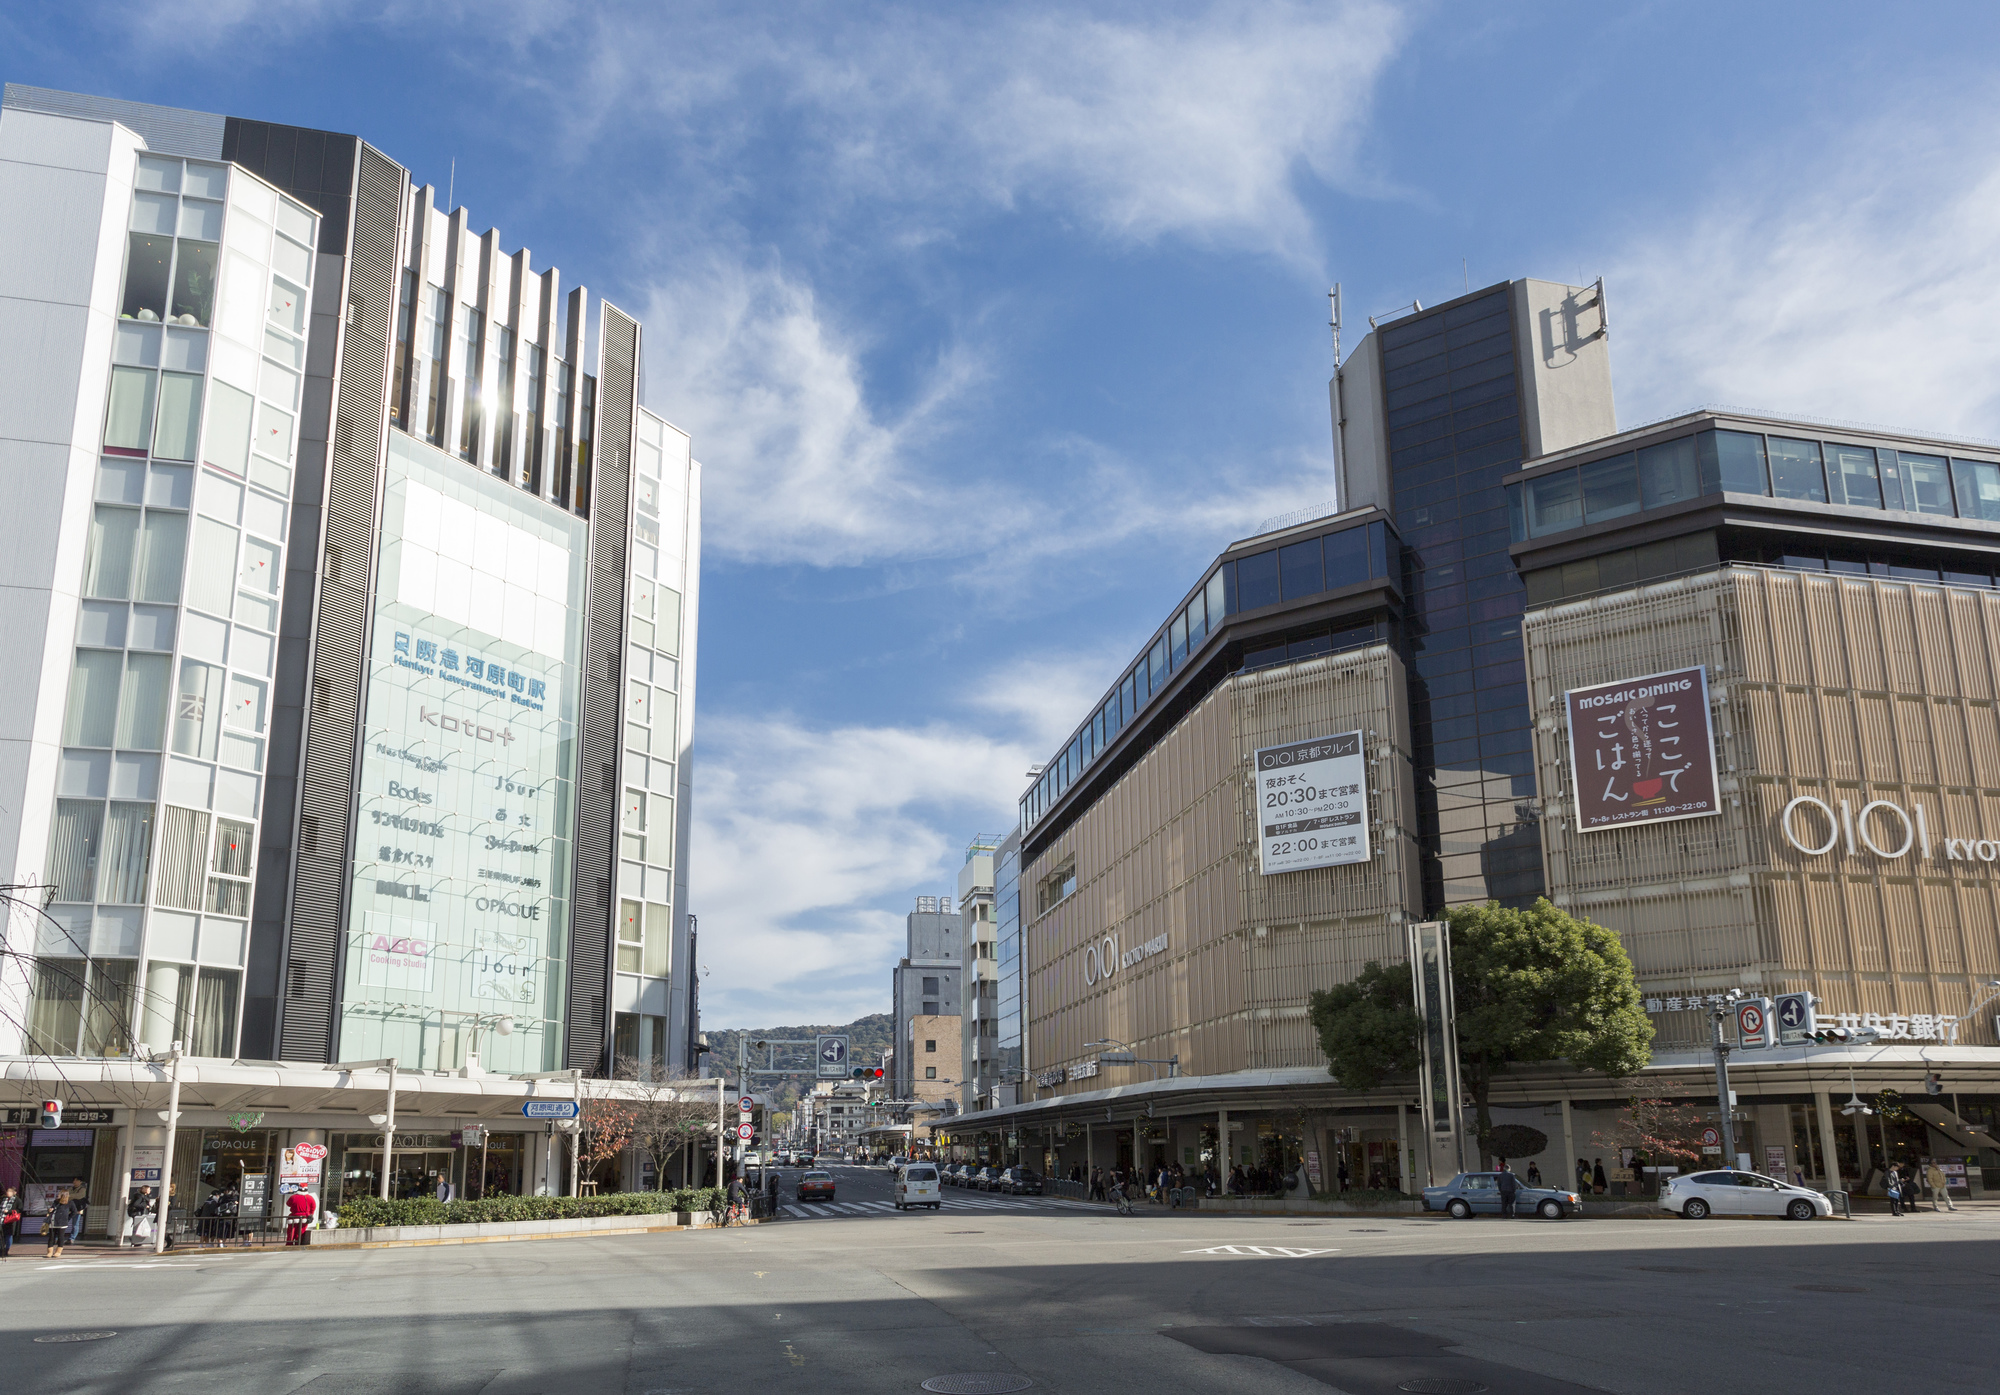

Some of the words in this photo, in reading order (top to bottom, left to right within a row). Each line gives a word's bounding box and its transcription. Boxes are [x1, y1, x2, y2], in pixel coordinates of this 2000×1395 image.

[416, 638, 545, 700] 阪急河原町駅
[394, 655, 434, 675] Hankyu
[439, 669, 506, 699] Kawaramachi
[510, 694, 543, 711] Station
[1579, 689, 1637, 709] MOSAIC
[1638, 679, 1692, 699] DINING
[1297, 740, 1354, 761] 京都マルイ
[1597, 710, 1629, 801] ごはん
[1656, 704, 1692, 793] ここで
[1266, 772, 1306, 789] 夜おそく
[475, 897, 540, 921] OPAQUE
[372, 935, 427, 957] ABC
[370, 953, 401, 968] Cooking
[403, 957, 426, 969] Studio
[481, 955, 529, 977] Jour
[1121, 945, 1145, 970] KYOTO
[519, 991, 533, 1001] 3F
[531, 1103, 571, 1111] 河原町通り
[212, 1140, 256, 1149] OPAQUE
